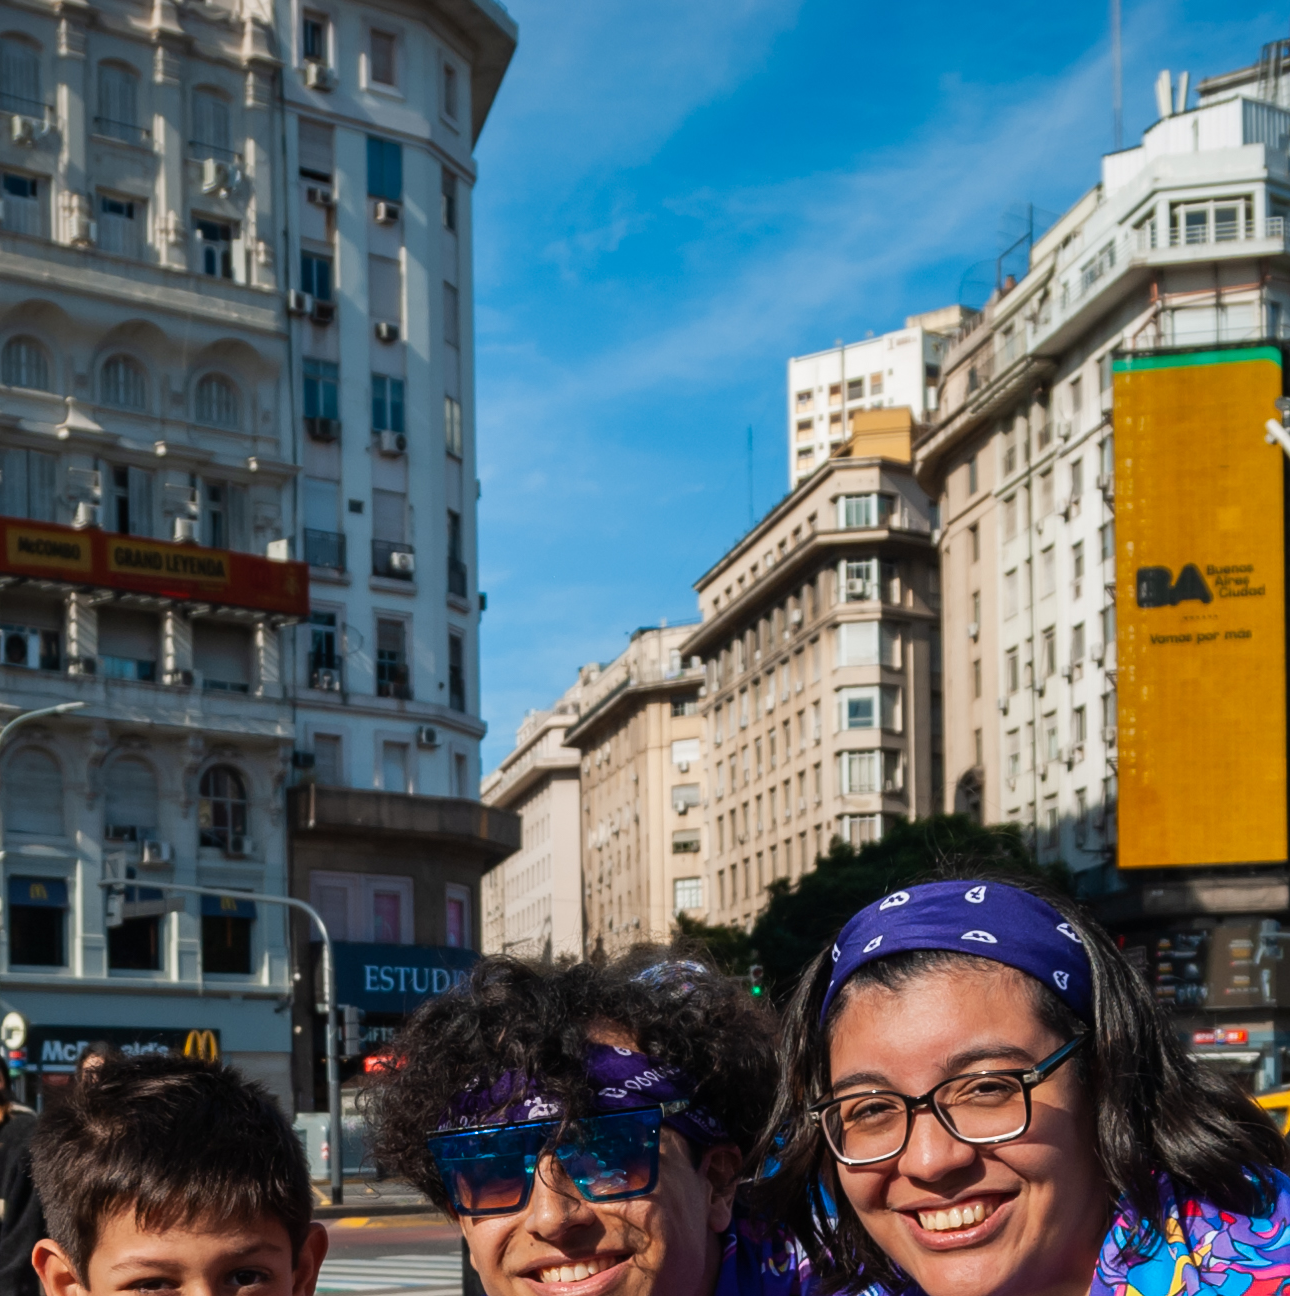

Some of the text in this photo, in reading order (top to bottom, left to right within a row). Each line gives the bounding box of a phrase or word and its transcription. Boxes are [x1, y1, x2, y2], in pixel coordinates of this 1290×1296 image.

[114, 546, 225, 577] GRAND LEYENDA
[1207, 564, 1254, 575] Buenos
[1137, 563, 1214, 608] BA
[1215, 576, 1250, 586] Aires
[1219, 584, 1265, 598] Ciudad
[1150, 628, 1252, 644] Vamos por más
